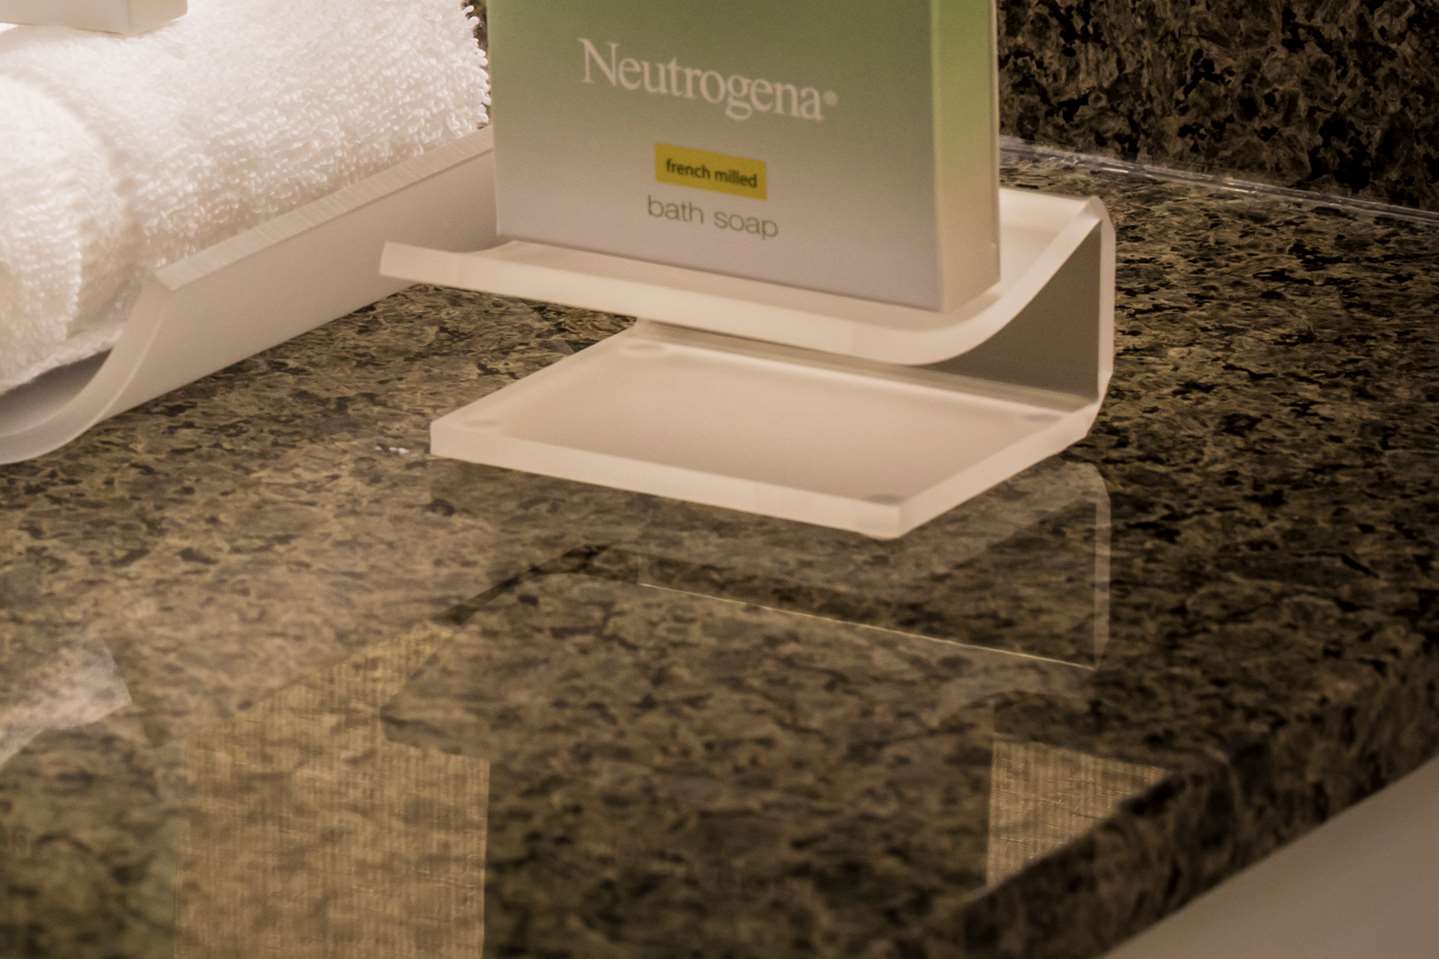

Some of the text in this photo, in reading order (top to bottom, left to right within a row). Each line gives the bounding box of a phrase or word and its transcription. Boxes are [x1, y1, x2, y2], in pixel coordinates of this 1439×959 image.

[666, 158, 758, 189] french milled
[647, 194, 779, 240] bath soap
